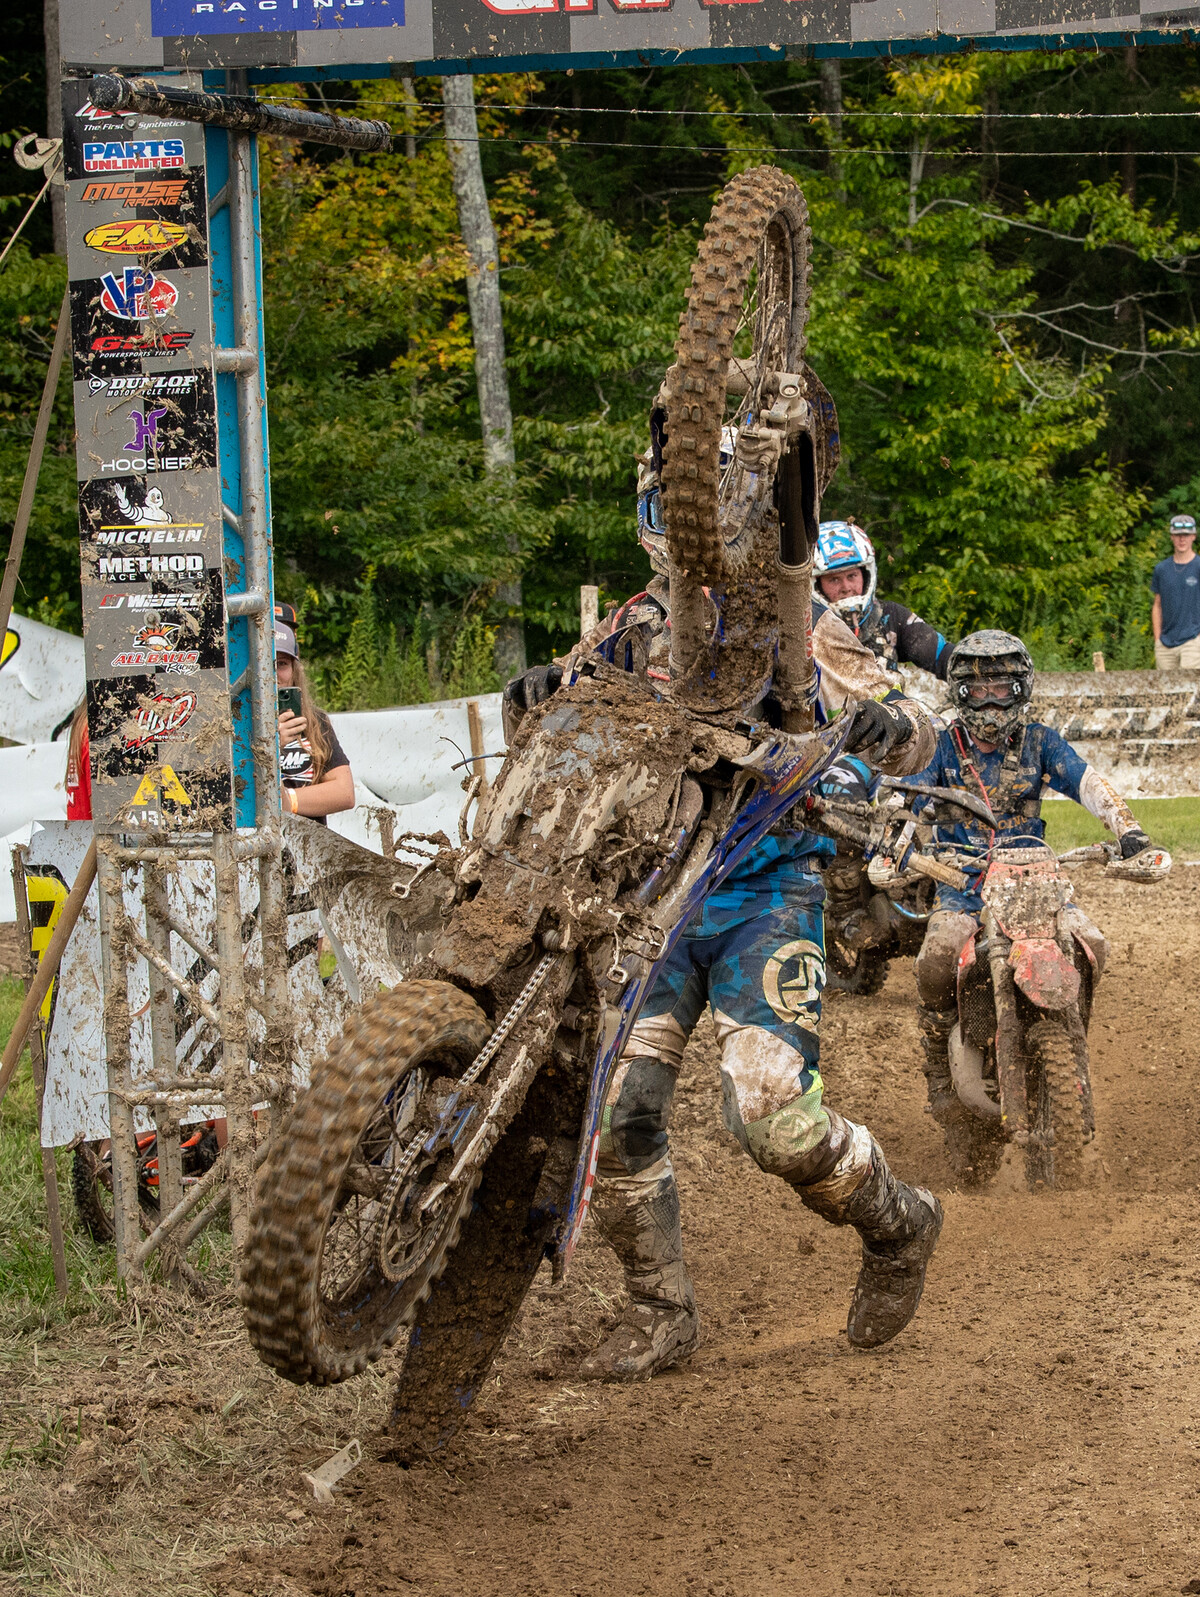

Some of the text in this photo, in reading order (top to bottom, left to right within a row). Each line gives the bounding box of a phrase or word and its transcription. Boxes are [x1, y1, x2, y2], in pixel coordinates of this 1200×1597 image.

[196, 0, 364, 13] RACING
[138, 121, 185, 129] Synthetics
[84, 140, 184, 160] PARTS
[85, 157, 184, 171] UNLIMITED
[81, 180, 188, 201] MOOSE
[122, 196, 180, 208] RACING
[87, 224, 188, 247] FMF
[100, 266, 155, 317] VP
[99, 351, 151, 359] POWERSPORTS
[108, 375, 198, 390] DUNLOP
[166, 387, 191, 395] TIRES
[101, 457, 193, 471] HOOSIER
[96, 529, 202, 545] MICHELIN
[99, 555, 204, 573] METHOD
[144, 572, 204, 580] WHEELS
[113, 652, 197, 665] ALL BALLS
